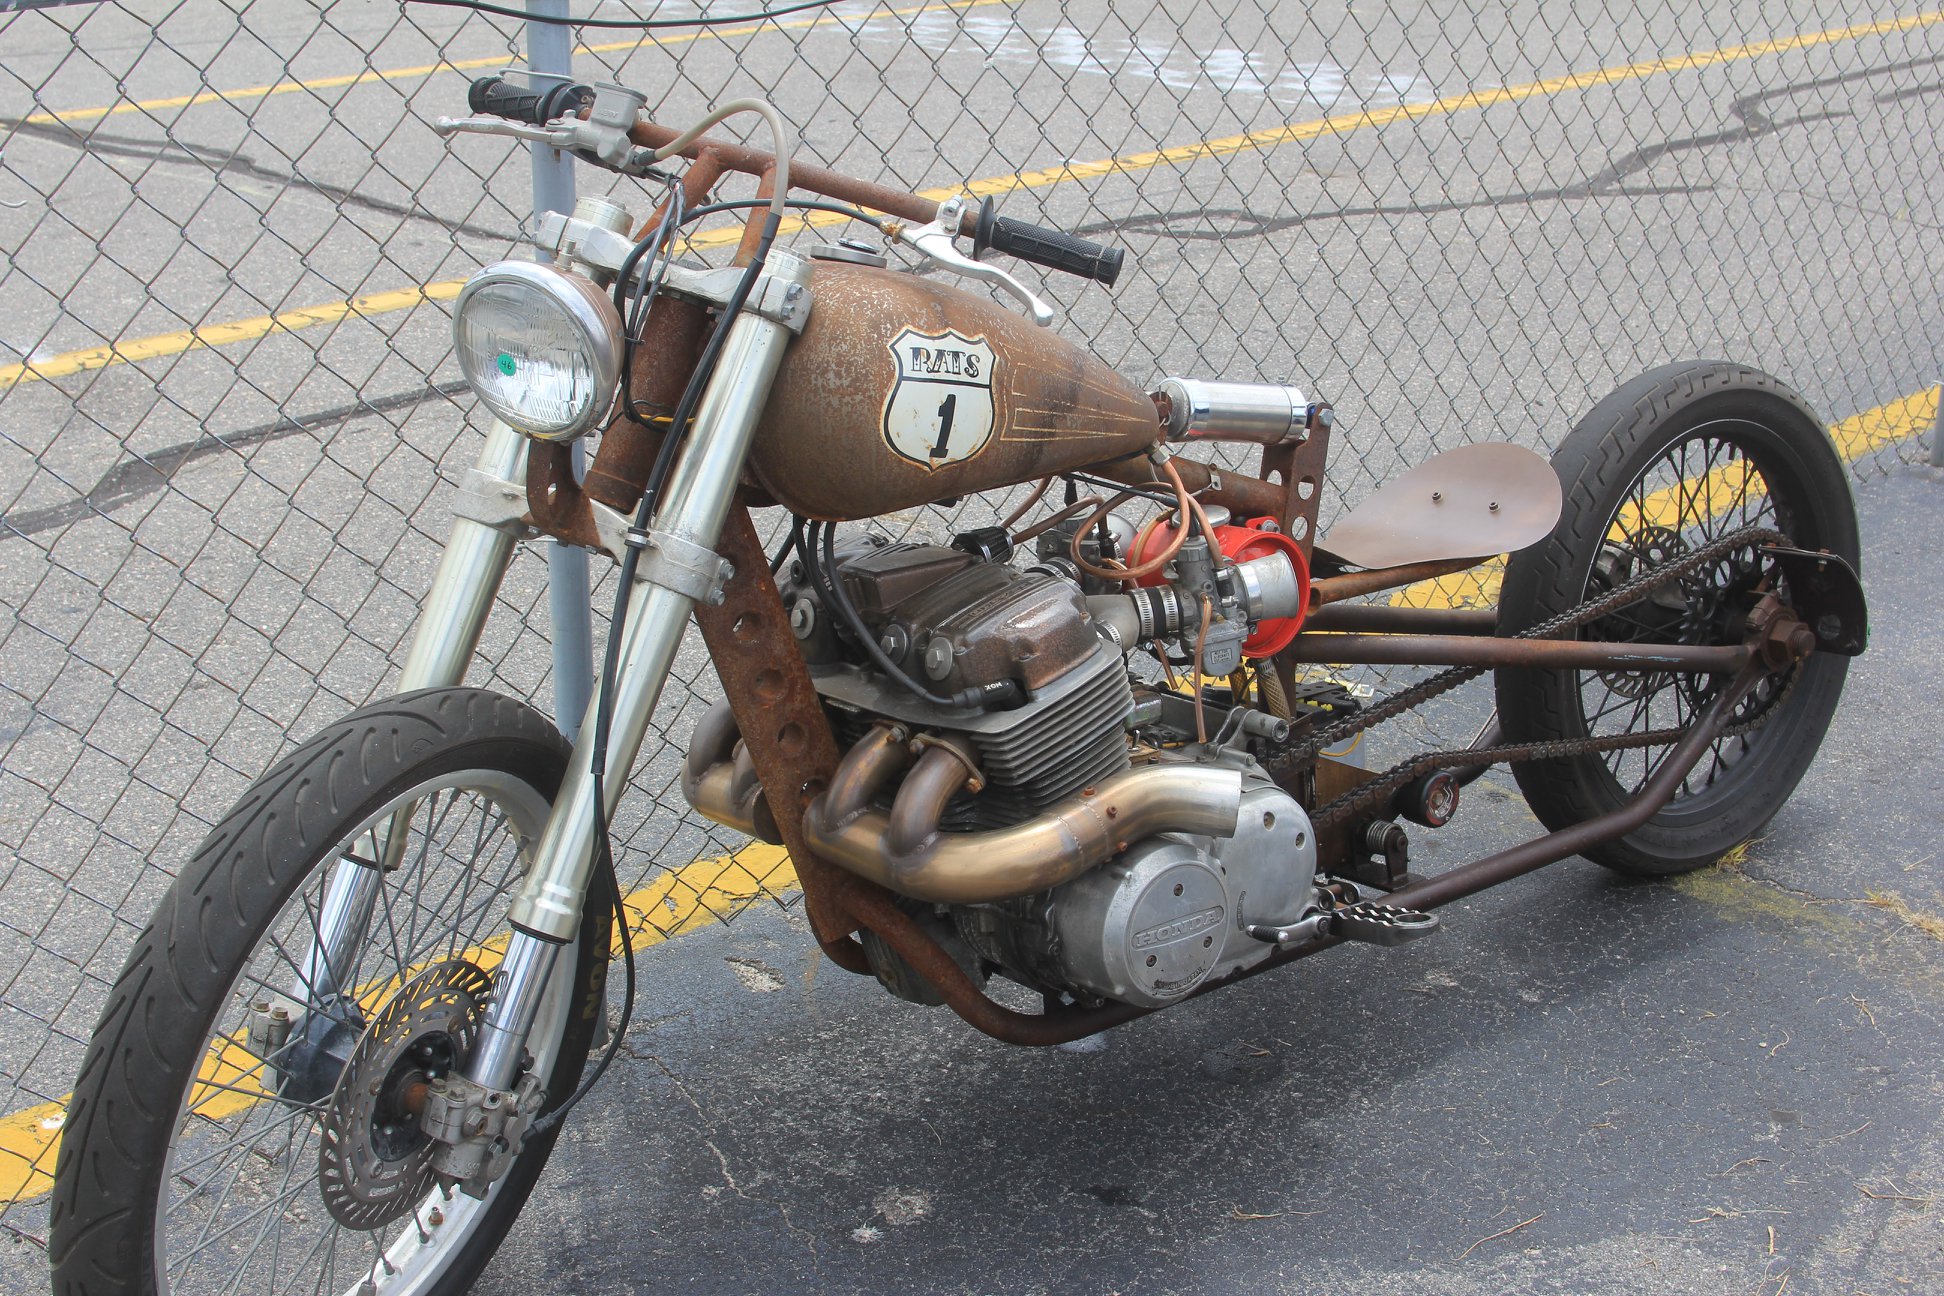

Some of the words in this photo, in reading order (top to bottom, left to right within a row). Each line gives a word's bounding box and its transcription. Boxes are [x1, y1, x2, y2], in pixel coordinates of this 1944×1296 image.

[501, 360, 512, 370] 46
[910, 347, 980, 378] RATS
[929, 394, 957, 458] 1
[1136, 911, 1220, 947] HONDA
